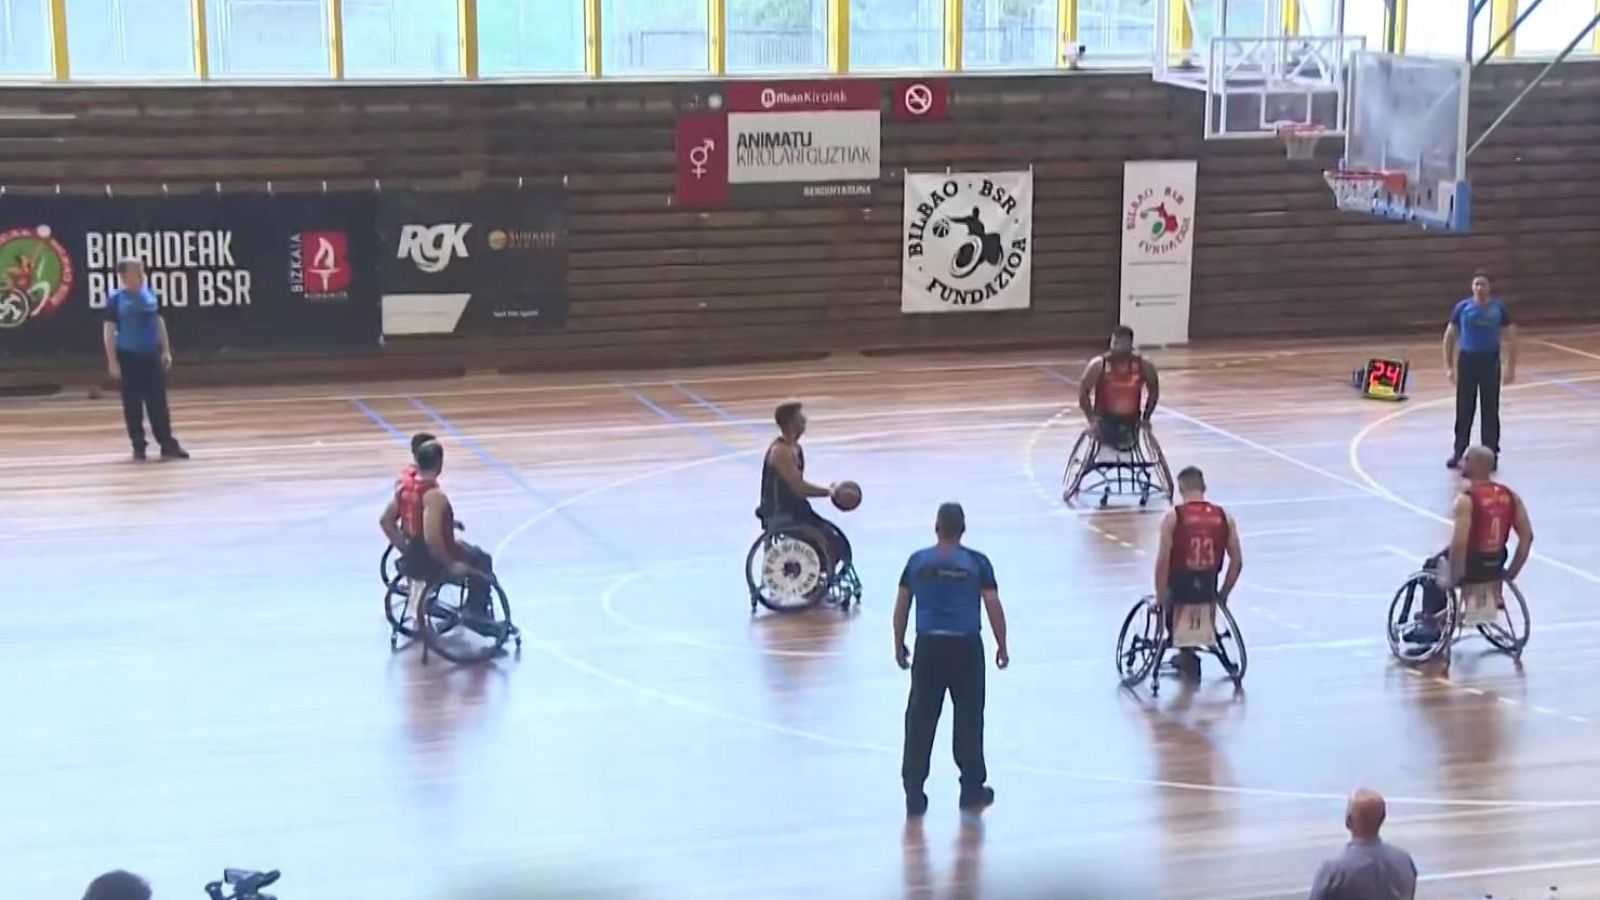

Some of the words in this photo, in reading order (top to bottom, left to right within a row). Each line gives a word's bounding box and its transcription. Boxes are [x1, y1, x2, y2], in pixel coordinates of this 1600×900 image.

[737, 131, 812, 150] ANIMATU
[737, 147, 804, 167] KIROLARI
[806, 145, 871, 165] GUZTIAK
[908, 180, 959, 259] BILBAO
[979, 179, 1017, 215] BSR
[86, 230, 235, 268] BIDAIDEAK
[290, 232, 304, 293] BIZKAIA
[88, 270, 188, 309] BIAO
[198, 269, 252, 306] BSR
[925, 237, 1027, 305] FUNDAZIOA
[1369, 361, 1400, 388] 24
[1186, 537, 1215, 567] 33
